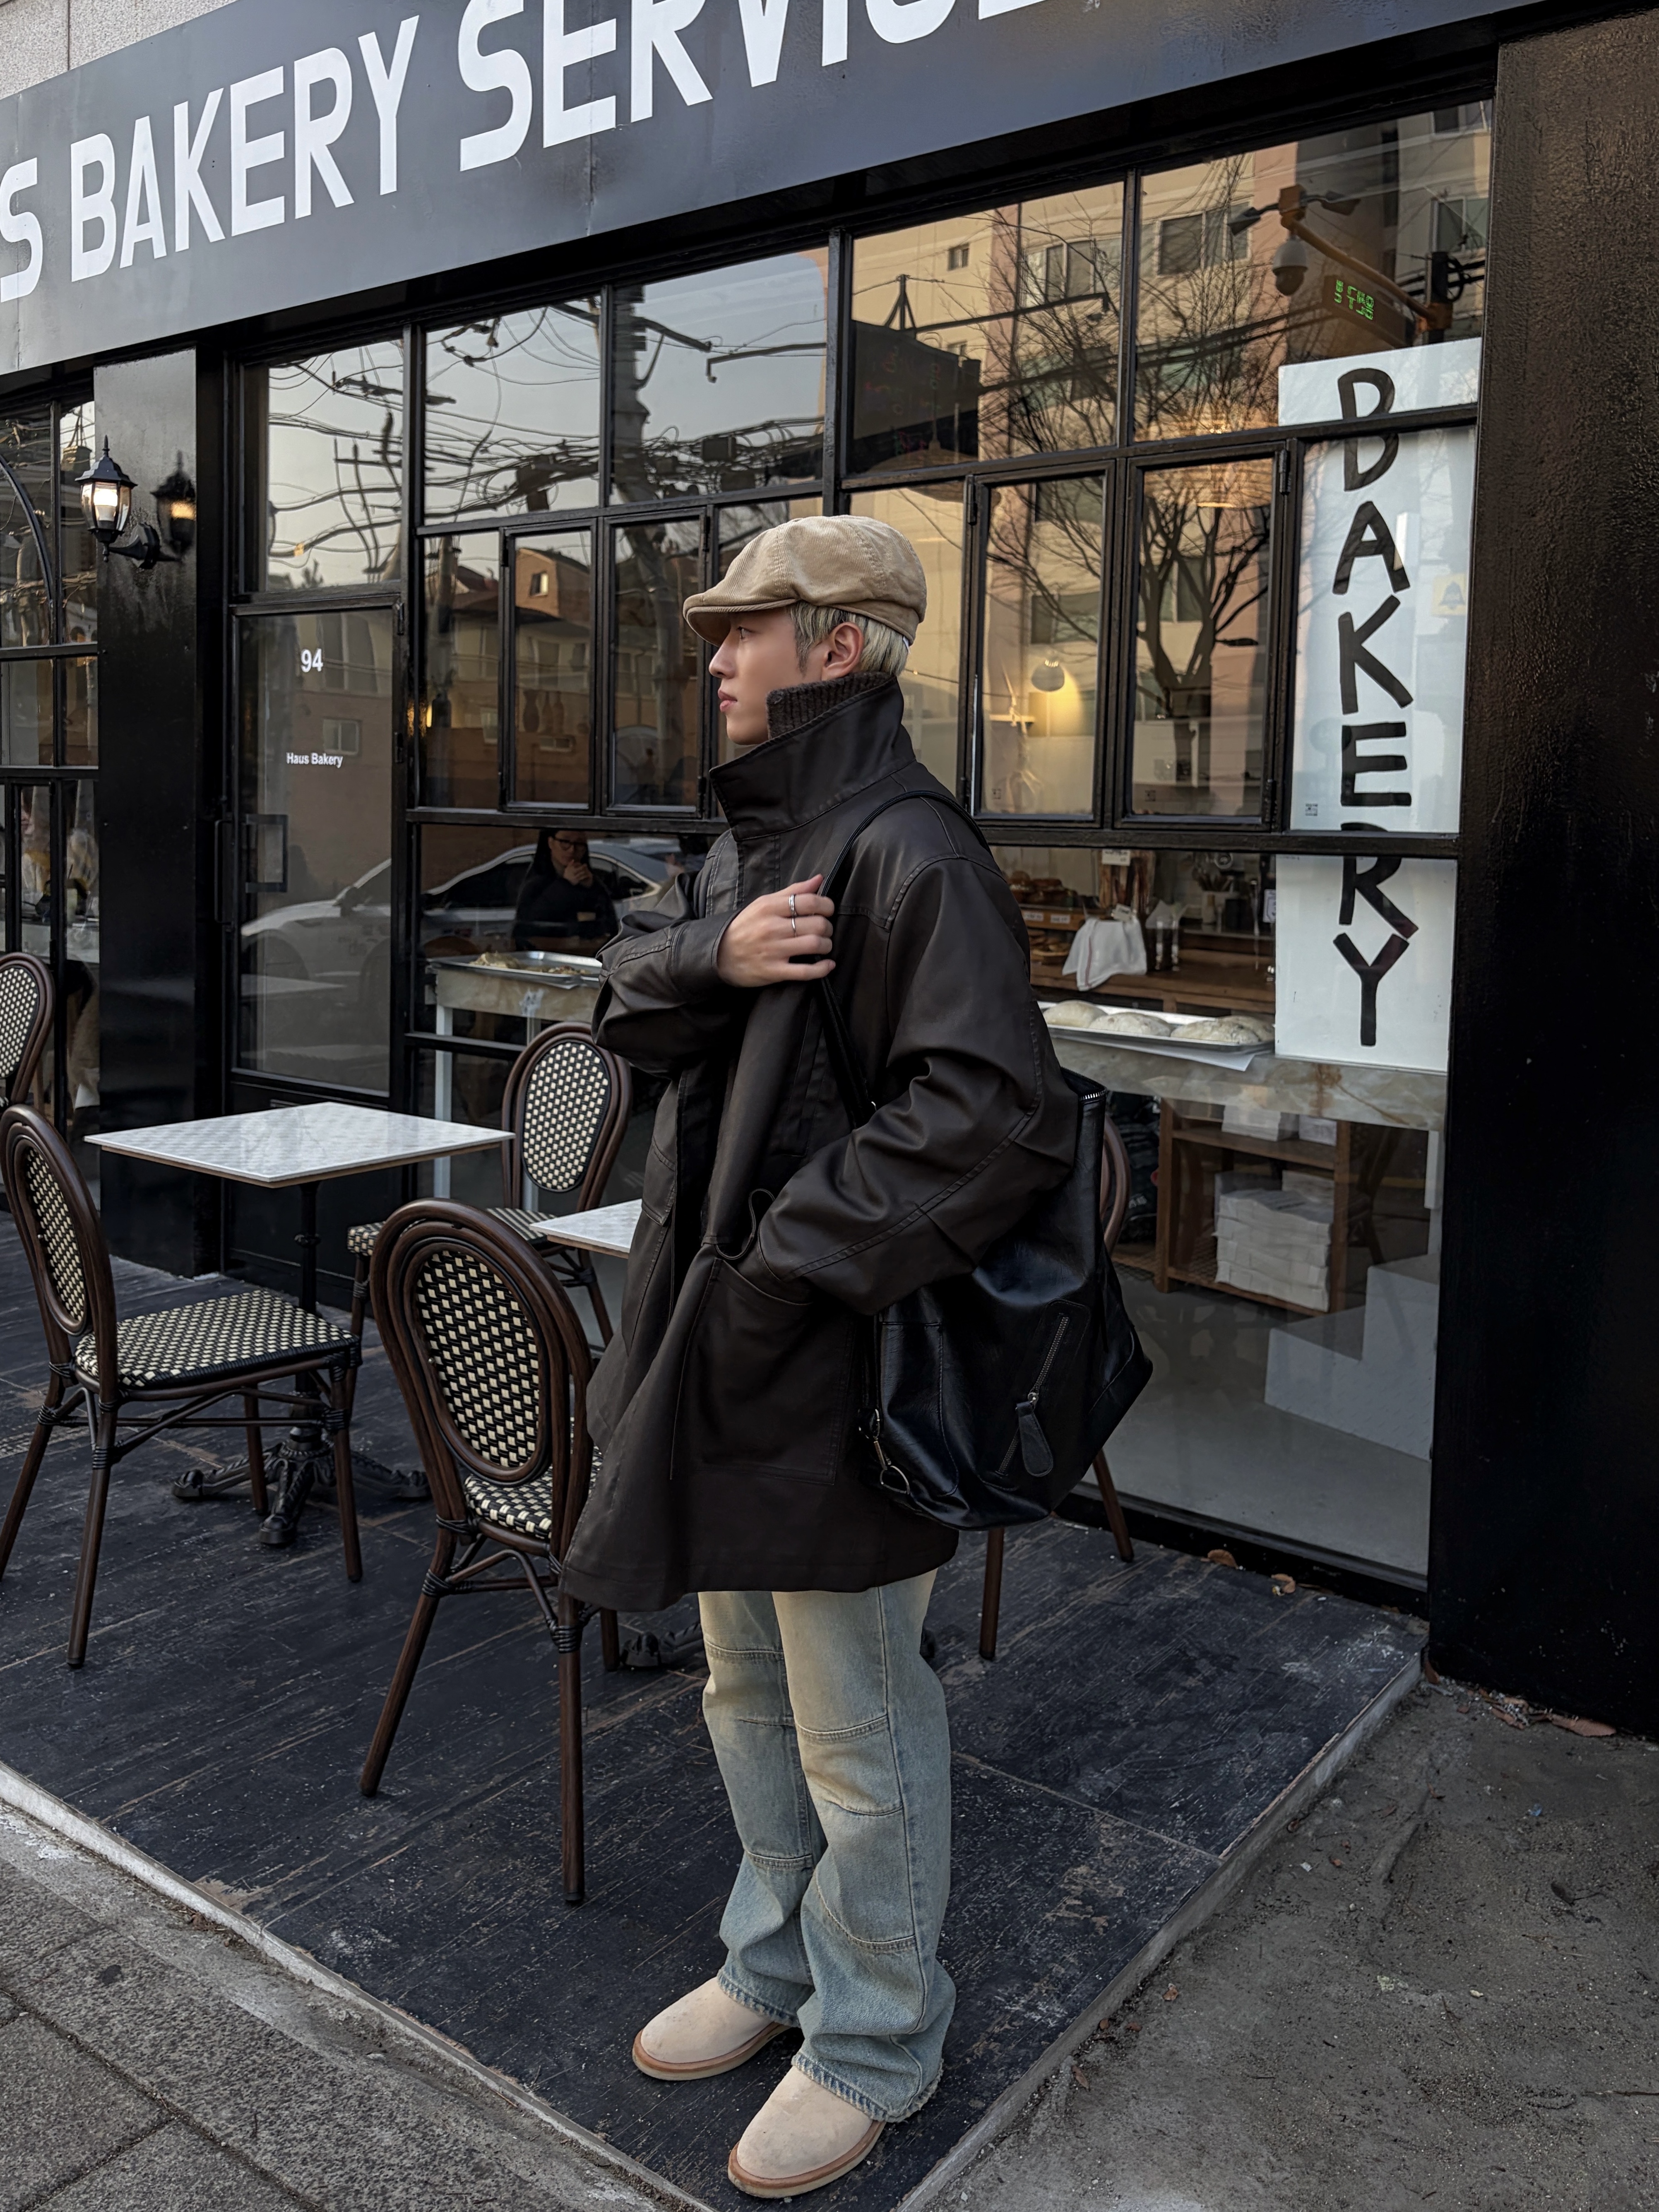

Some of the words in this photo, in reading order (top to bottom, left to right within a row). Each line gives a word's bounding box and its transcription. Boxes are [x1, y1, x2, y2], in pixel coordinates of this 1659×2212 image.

[70, 15, 419, 282] BAKERY
[301, 648, 324, 672] 94
[1333, 367, 1419, 1047] BAKERY
[286, 752, 310, 765] Haus
[311, 752, 343, 768] Bakery
